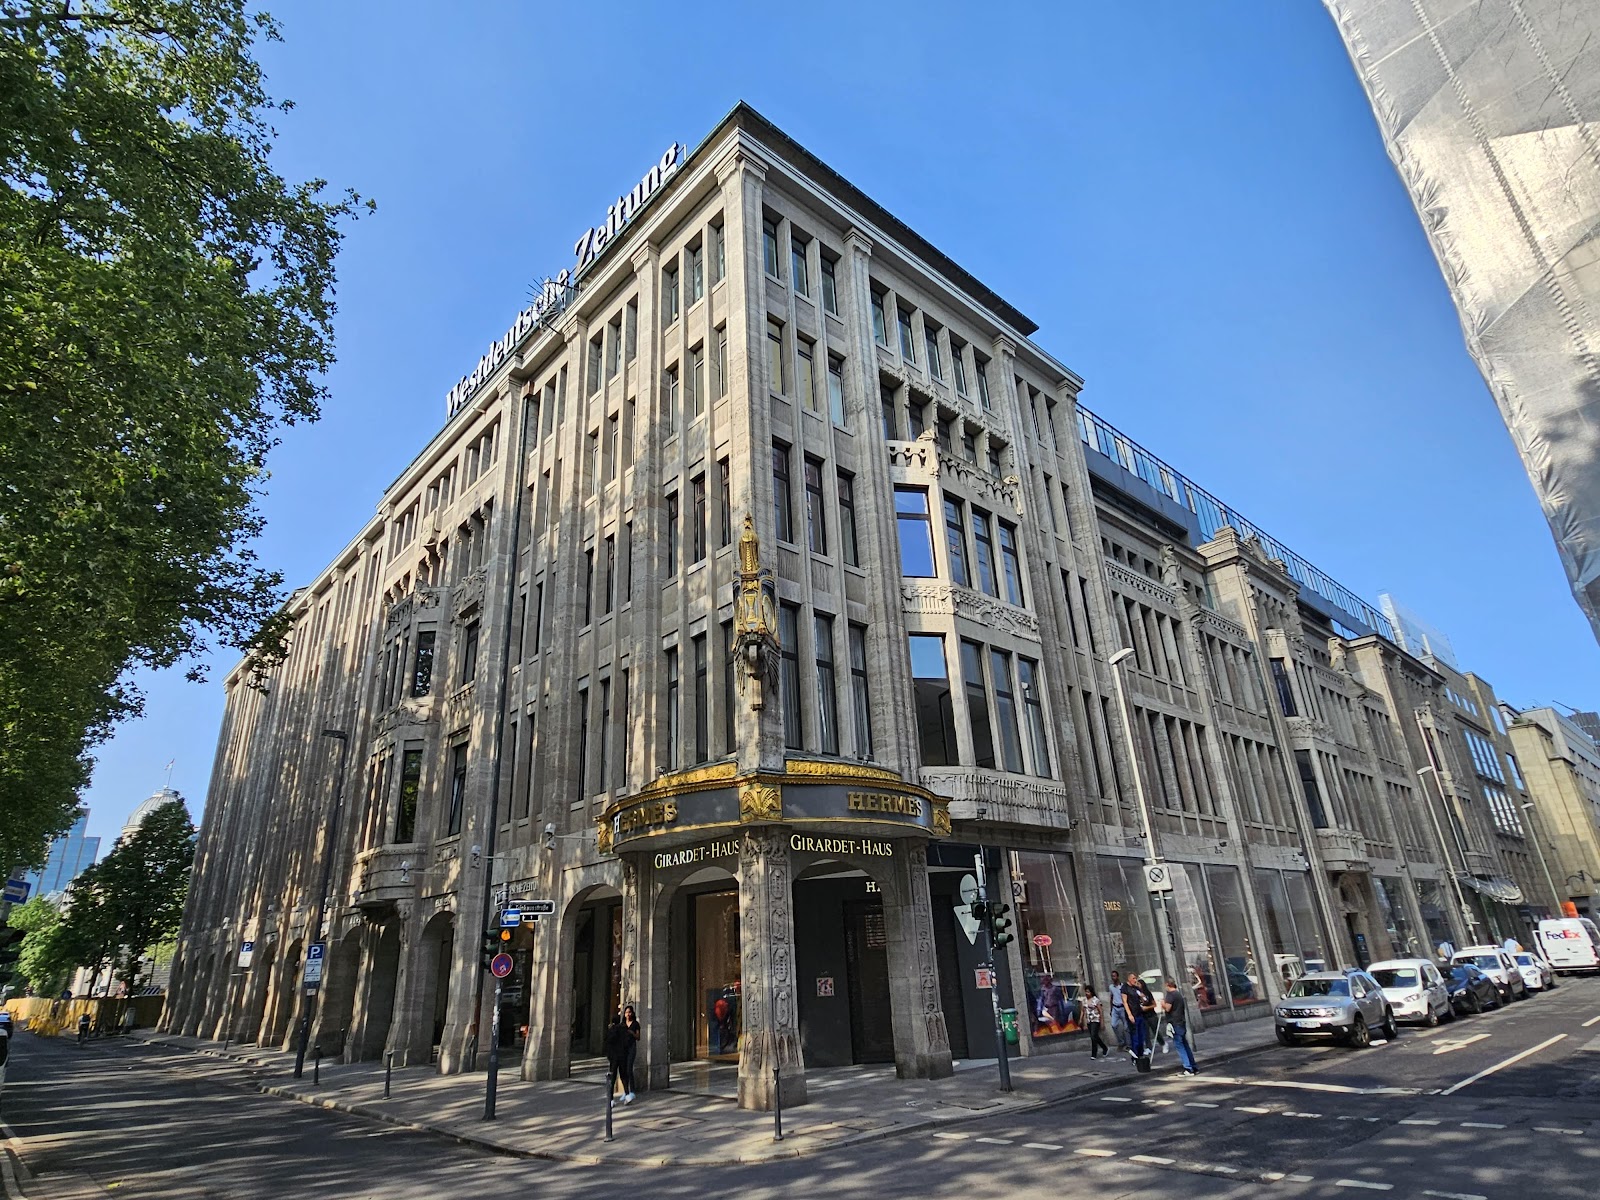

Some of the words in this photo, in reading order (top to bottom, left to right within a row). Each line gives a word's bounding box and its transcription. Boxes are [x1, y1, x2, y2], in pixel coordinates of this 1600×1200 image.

[446, 268, 569, 418] Westdeutsche
[574, 141, 679, 272] Zeitung
[1545, 930, 1581, 939] FedEx
[310, 946, 320, 958] P
